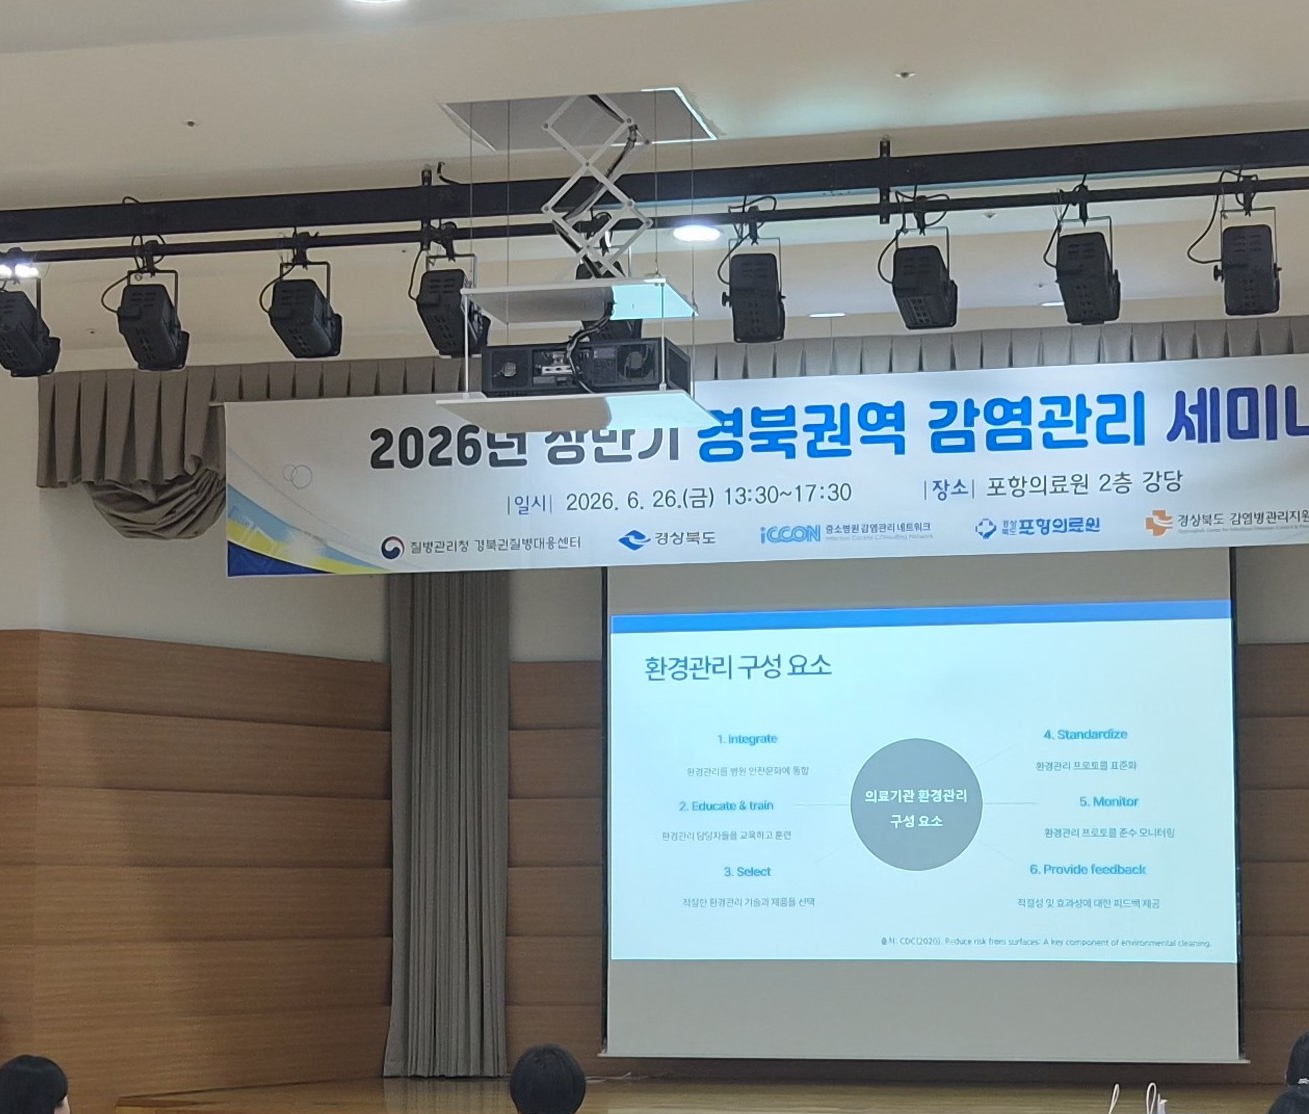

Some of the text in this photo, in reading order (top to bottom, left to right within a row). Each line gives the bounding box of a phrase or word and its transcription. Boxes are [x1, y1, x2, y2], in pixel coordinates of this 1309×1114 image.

[370, 424, 528, 469] 2026년
[697, 402, 907, 463] 경북권역
[928, 391, 1147, 457] 감염관리
[987, 472, 1090, 498] 포항의료원
[1098, 471, 1133, 495] 2층
[1142, 468, 1184, 494] 강당
[566, 492, 619, 513] 2026.
[626, 491, 646, 511] 6.
[724, 482, 852, 506] 13:30~17:30
[861, 522, 896, 534] 감염관리
[896, 521, 931, 533] 네트워크
[1019, 517, 1101, 535] 포항의료원
[1177, 513, 1225, 528] 경상북도
[655, 531, 716, 546] 경상북도
[410, 540, 469, 554] 질병관리청
[644, 654, 833, 682] 환경관리 구성 요소
[728, 733, 778, 746] Integrate
[1043, 728, 1128, 740] 4. Standardize
[864, 788, 968, 804] 의료기관 환경관리
[1079, 796, 1139, 807] 5. Monitor
[692, 800, 737, 811] Educate
[749, 799, 774, 811] train
[890, 814, 943, 829] 구성 요소
[723, 866, 772, 877] 3. Select
[1030, 864, 1147, 875] 6. Provide feedback
